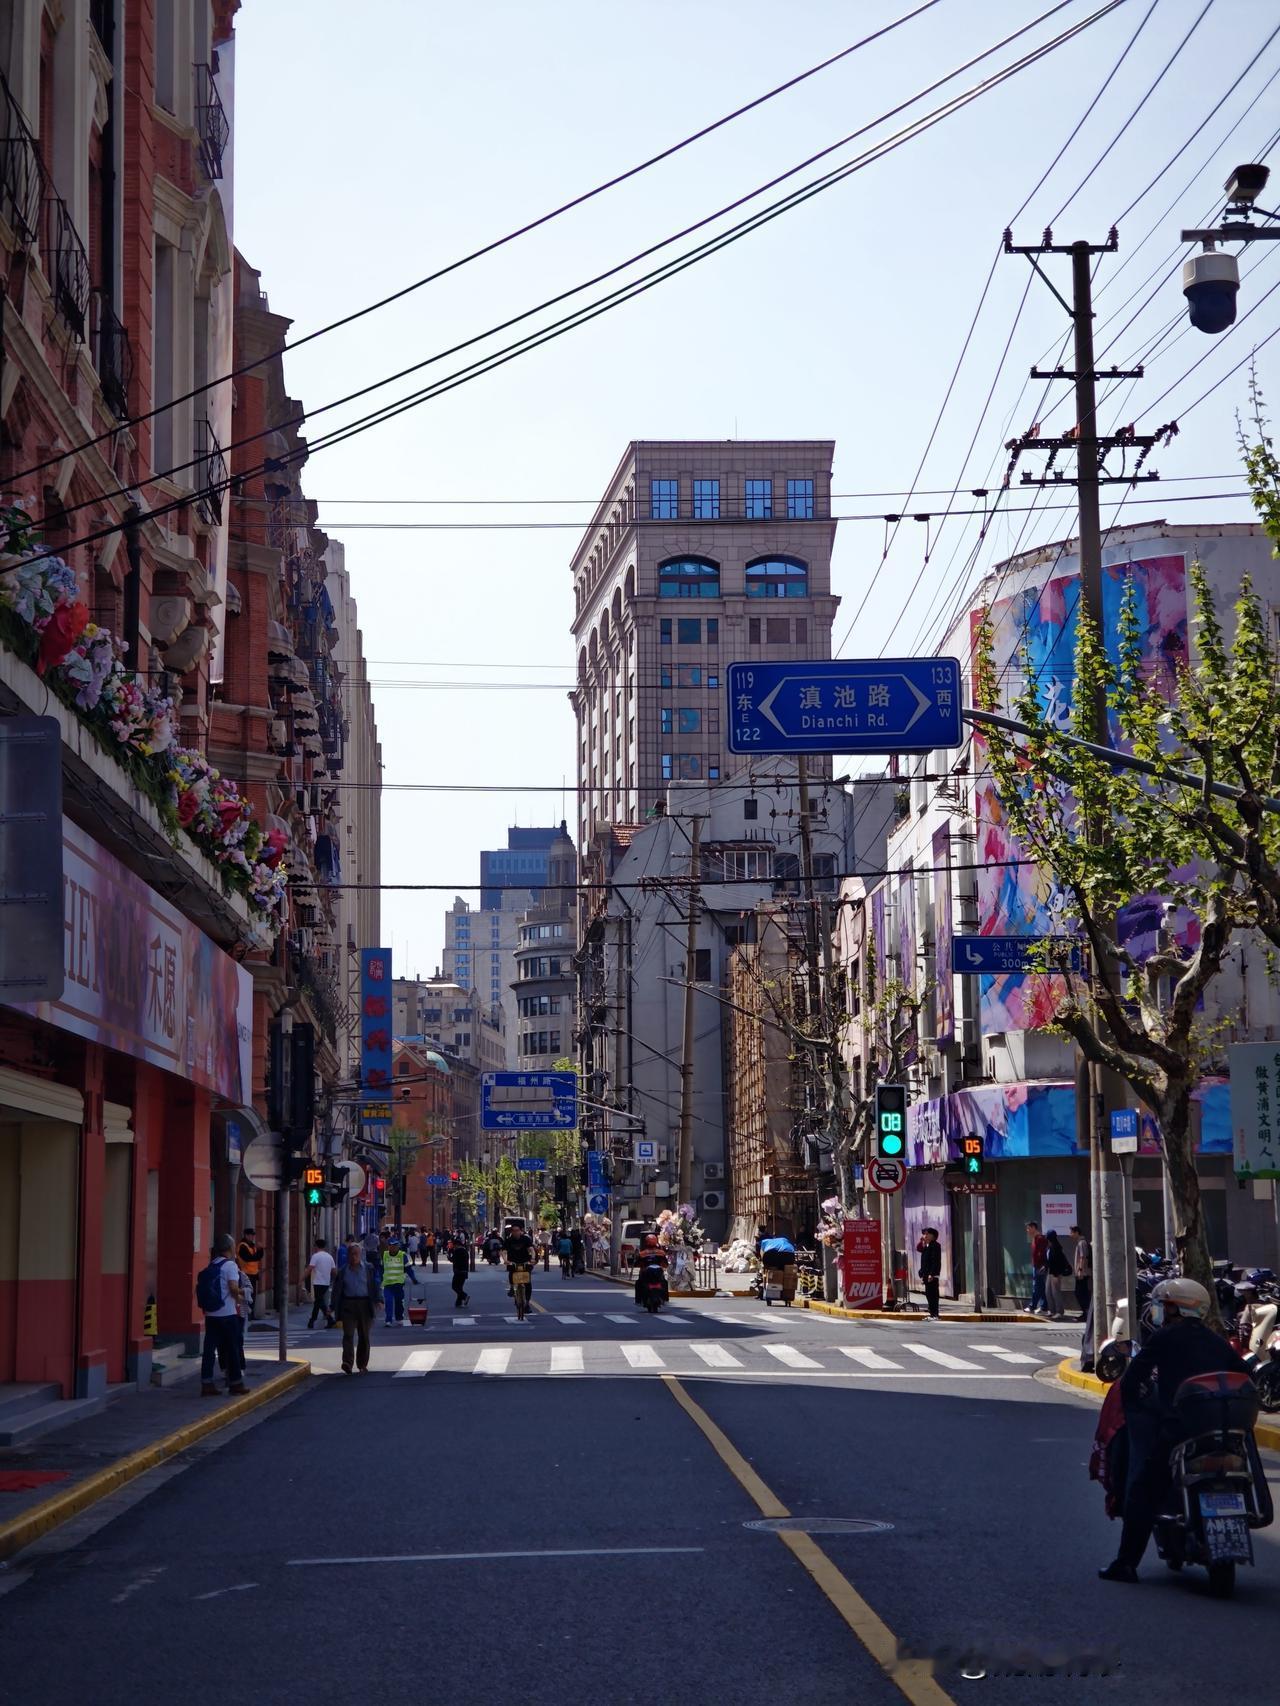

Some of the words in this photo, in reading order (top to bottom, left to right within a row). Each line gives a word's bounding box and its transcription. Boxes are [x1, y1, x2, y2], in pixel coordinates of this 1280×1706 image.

[736, 671, 754, 689] 119
[931, 667, 952, 685] 133
[736, 694, 753, 711] 东
[799, 683, 891, 709] 滇池路
[936, 689, 953, 706] 西
[741, 713, 749, 723] E
[801, 713, 859, 729] Dianchi
[867, 712, 889, 727] Rd.
[939, 707, 951, 718] W
[736, 727, 761, 741] 122
[1002, 958, 1029, 969] 300m
[881, 1113, 902, 1131] 08
[965, 1139, 981, 1153] 05
[307, 1169, 323, 1184] 05
[849, 1282, 882, 1297] RUN
